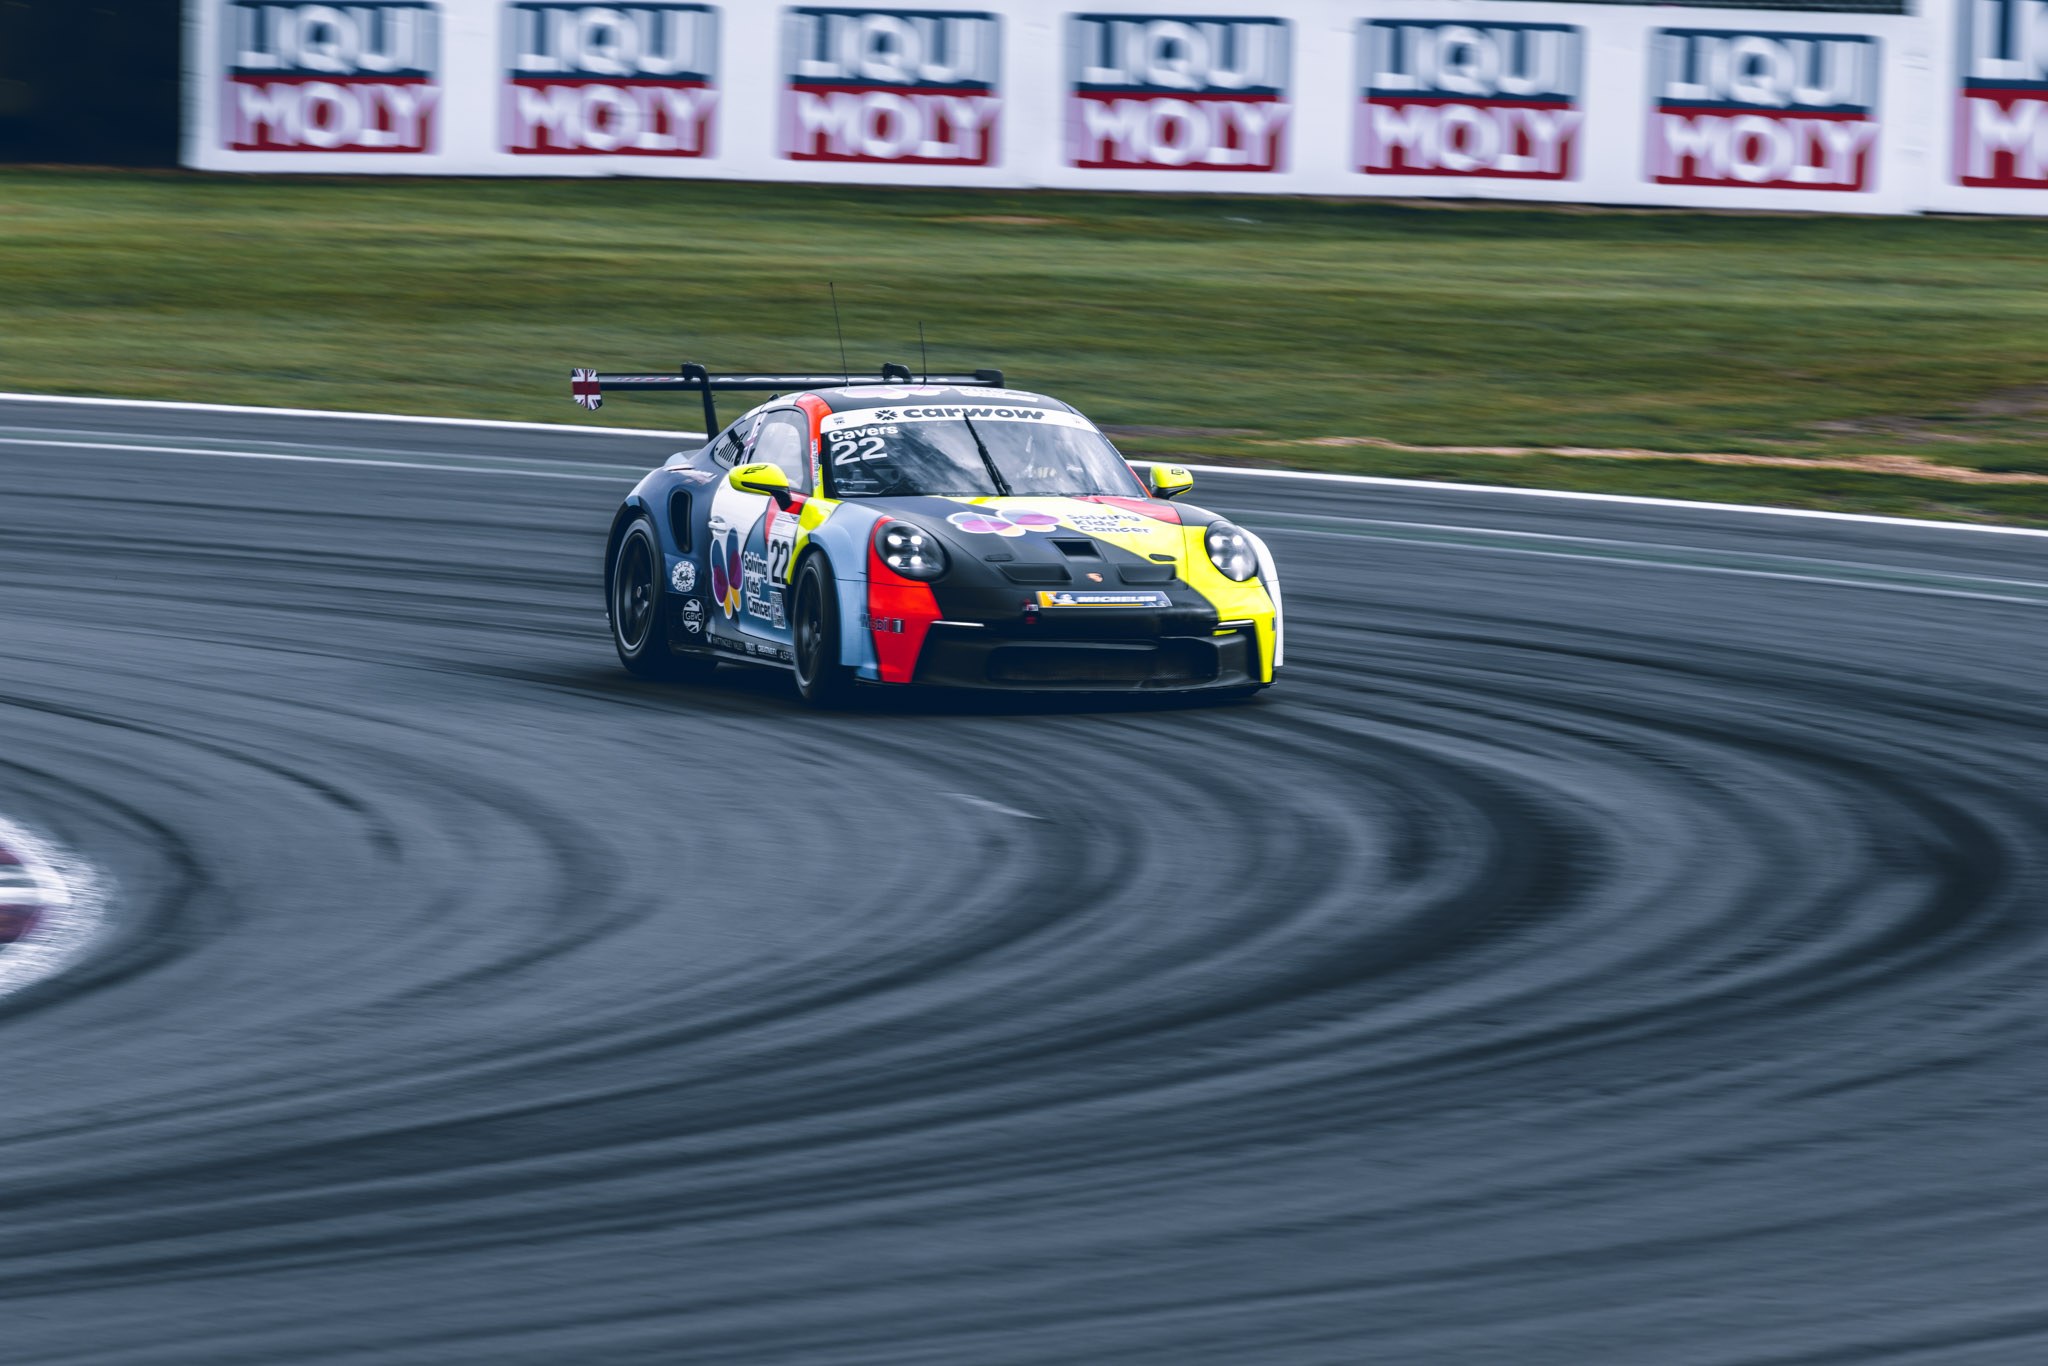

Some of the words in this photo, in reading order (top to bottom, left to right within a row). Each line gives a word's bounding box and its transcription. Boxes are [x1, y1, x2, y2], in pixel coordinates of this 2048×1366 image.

[226, 80, 440, 150] MOLY
[506, 84, 720, 152] MOLY
[786, 91, 1001, 160] MOLY
[1071, 97, 1293, 167] MOLY
[1363, 102, 1582, 175] MOLY
[1656, 112, 1880, 185] MOLY
[902, 407, 1045, 420] carwow
[828, 425, 899, 442] Cavers
[831, 436, 888, 467] 22
[1066, 514, 1141, 522] Solving
[1080, 525, 1150, 534] Cancer
[744, 552, 768, 583] Solving
[770, 540, 791, 585] 22
[747, 596, 771, 619] Cancer
